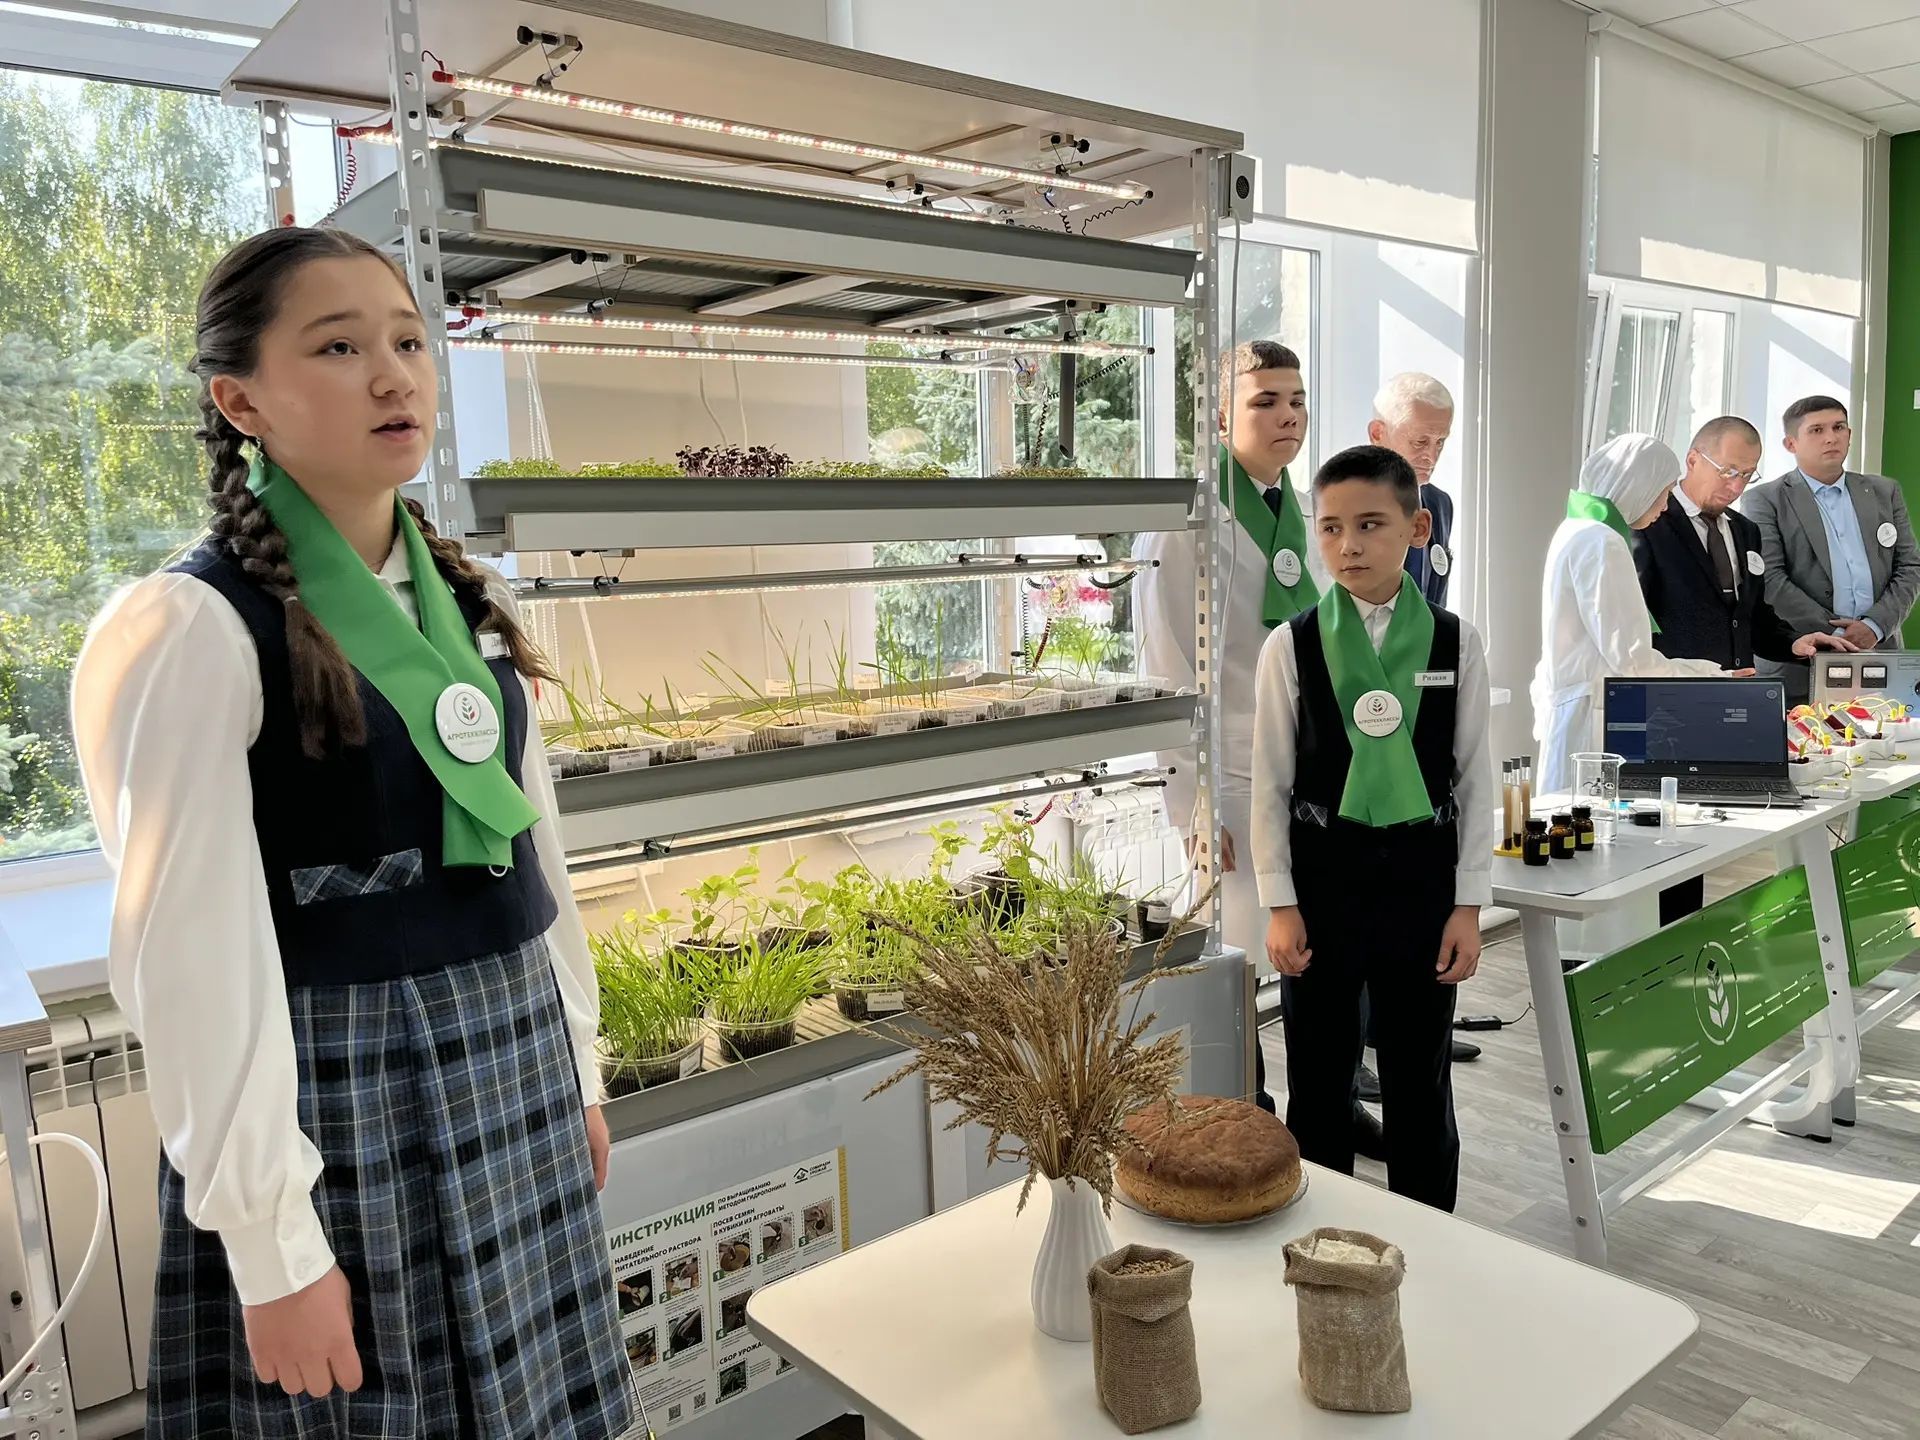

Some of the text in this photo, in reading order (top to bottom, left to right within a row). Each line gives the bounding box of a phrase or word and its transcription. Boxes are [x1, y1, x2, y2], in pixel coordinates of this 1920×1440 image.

[447, 728, 498, 741] АГРОТЕХКЛАССЫ
[718, 1182, 787, 1211] МЕТОДОМ ГИДРОПОНИКИ
[727, 1181, 771, 1201] ВЫРАЩИВАНИЮ
[610, 1201, 715, 1250] ИНСТРУКЦИЯ
[713, 1208, 755, 1228] ПОСЕВ СЕМЯН
[718, 1221, 744, 1234] КУБИКИ
[753, 1205, 785, 1221] АГРОВАТЫ
[614, 1245, 655, 1265] НАВЕДЕНИЕ
[615, 1236, 702, 1273] ПИТАТЕЛЬНОГО РАСТВОРА
[719, 1352, 738, 1365] СБОР
[738, 1341, 764, 1357] УРОЖА
